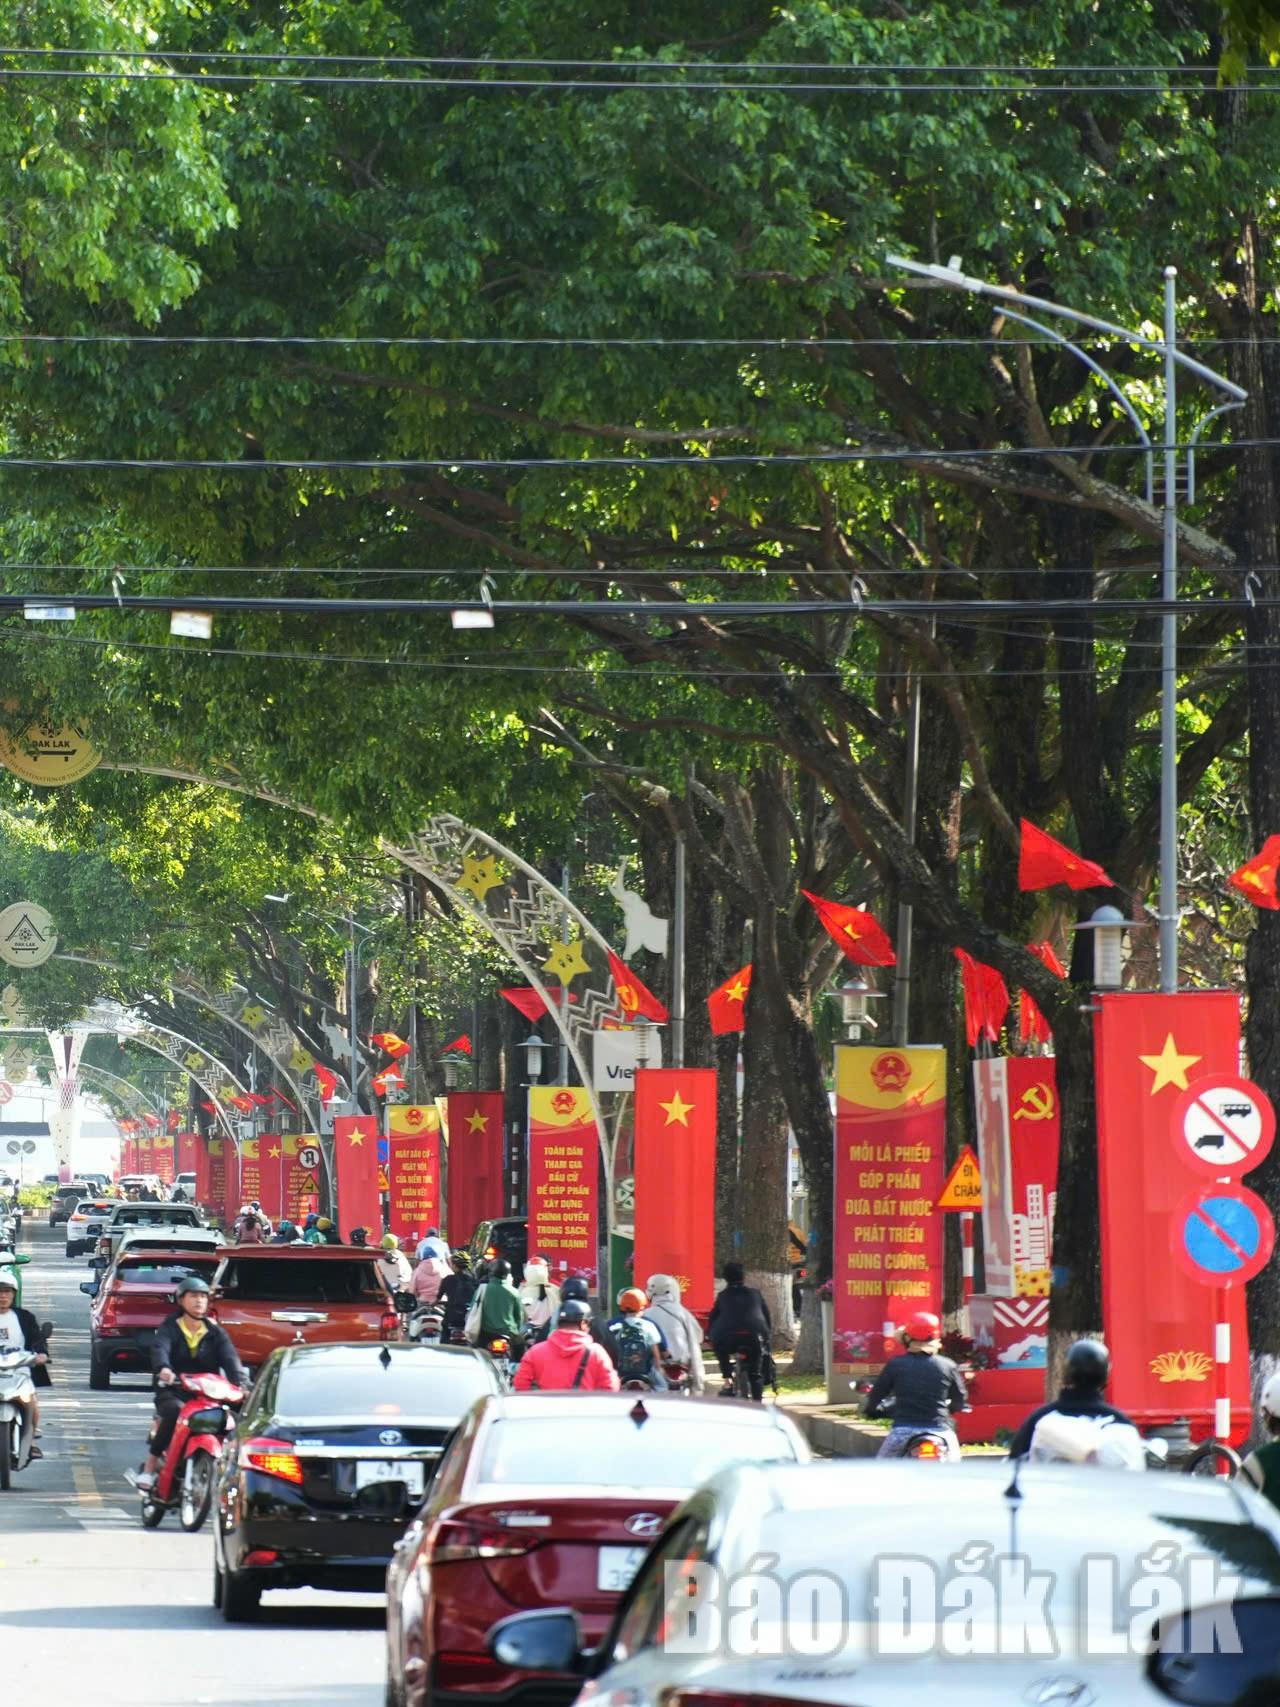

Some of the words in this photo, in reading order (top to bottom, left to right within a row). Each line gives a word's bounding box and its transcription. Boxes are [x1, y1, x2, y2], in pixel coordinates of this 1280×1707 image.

[606, 1065, 632, 1079] Vie
[850, 1140, 873, 1161] MỖI
[895, 1141, 931, 1162] PHIẾU
[859, 1169, 884, 1188] GÓP
[887, 1168, 920, 1189] PHẦN
[963, 1165, 973, 1176] ĐI
[846, 1199, 870, 1215] ĐƯA
[874, 1195, 896, 1216] ĐẤT
[900, 1198, 932, 1216] NƯỚC
[854, 1224, 885, 1242] PHÁT
[888, 1221, 924, 1243] TRIỂN
[848, 1250, 881, 1269] HÙNG
[847, 1280, 882, 1298] THỊNH
[886, 1280, 930, 1300] VƯỢNG!
